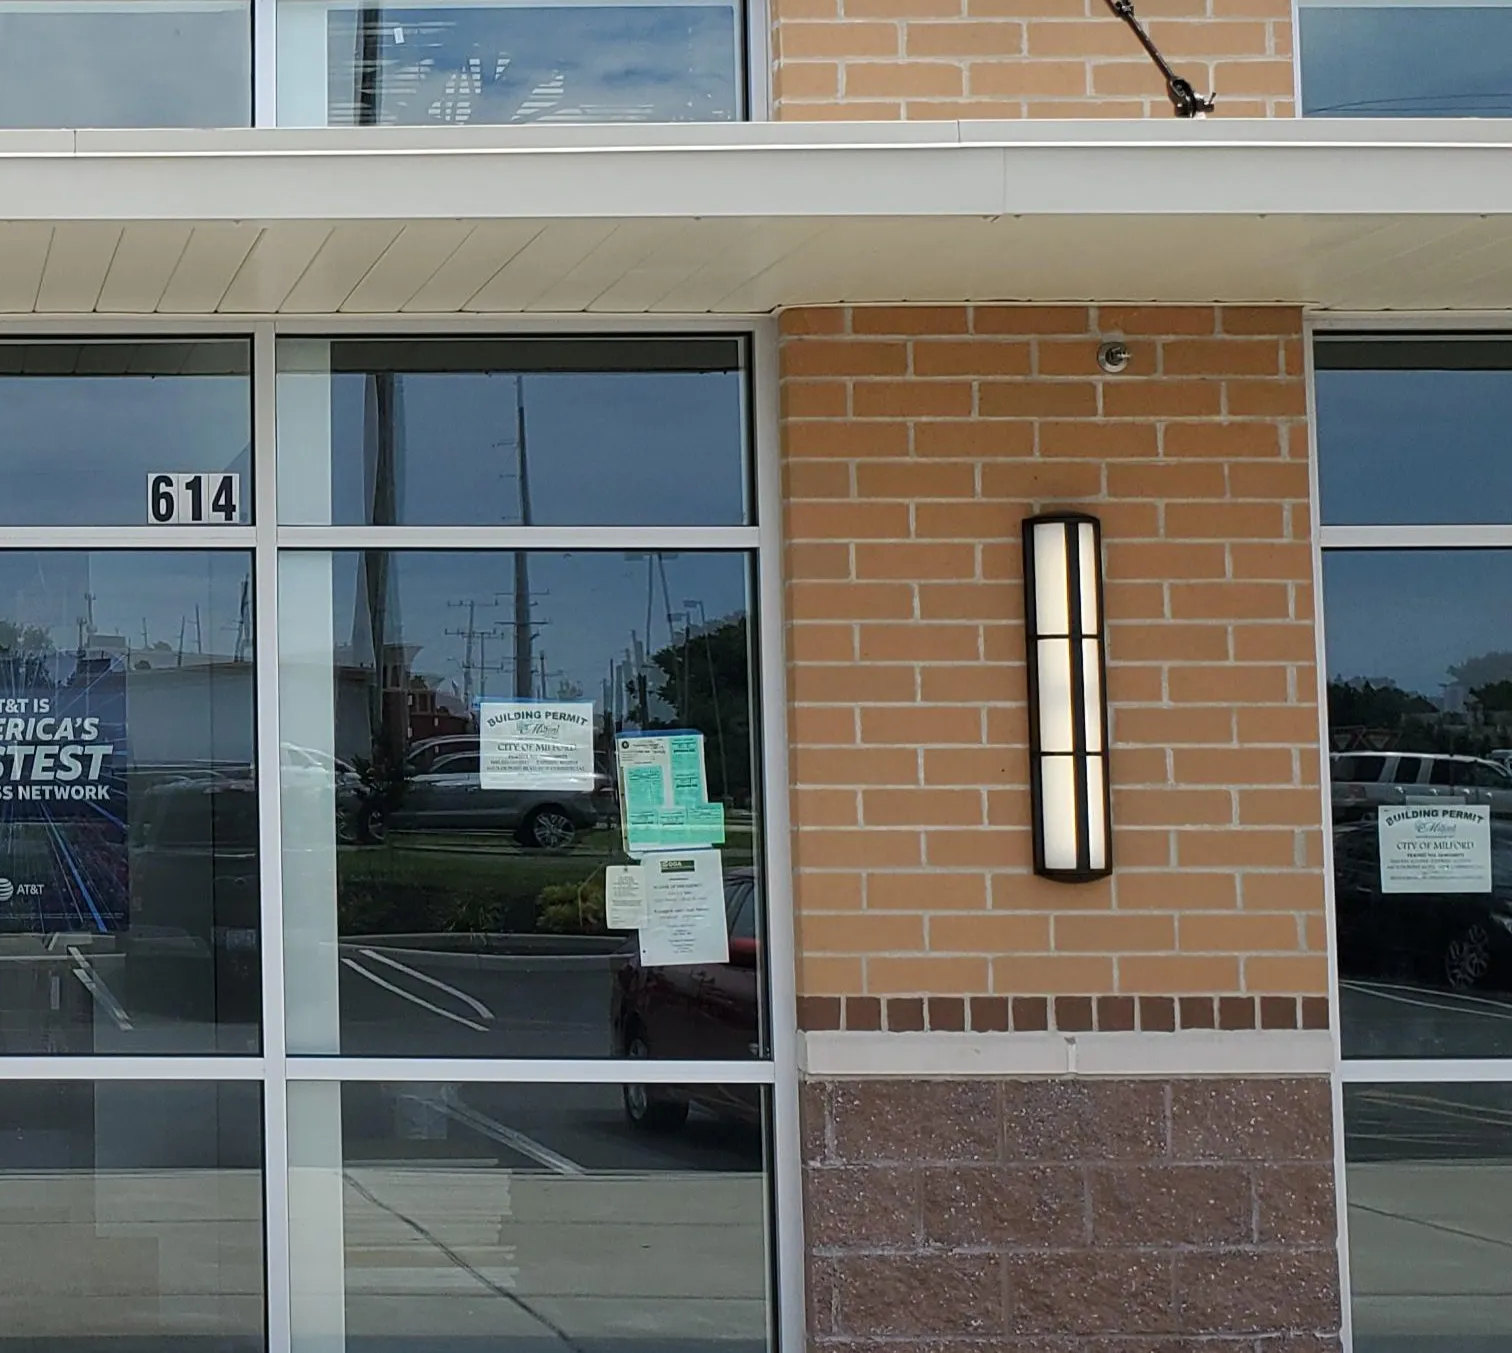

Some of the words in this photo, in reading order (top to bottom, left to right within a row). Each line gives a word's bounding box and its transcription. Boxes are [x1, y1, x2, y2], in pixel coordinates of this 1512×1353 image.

[151, 474, 237, 523] 614
[33, 698, 50, 713] IS
[486, 710, 542, 728] BUILDING
[544, 711, 589, 726] PERMIT
[497, 743, 521, 752] CITY
[521, 743, 533, 752] OF
[18, 785, 111, 800] NETWORK
[1385, 809, 1439, 827] BUILDING
[1442, 809, 1485, 824] PERMIT
[1396, 841, 1417, 850] CITY
[1419, 841, 1432, 850] OF
[1433, 841, 1475, 850] MILFORD
[16, 884, 45, 896] AT&T
